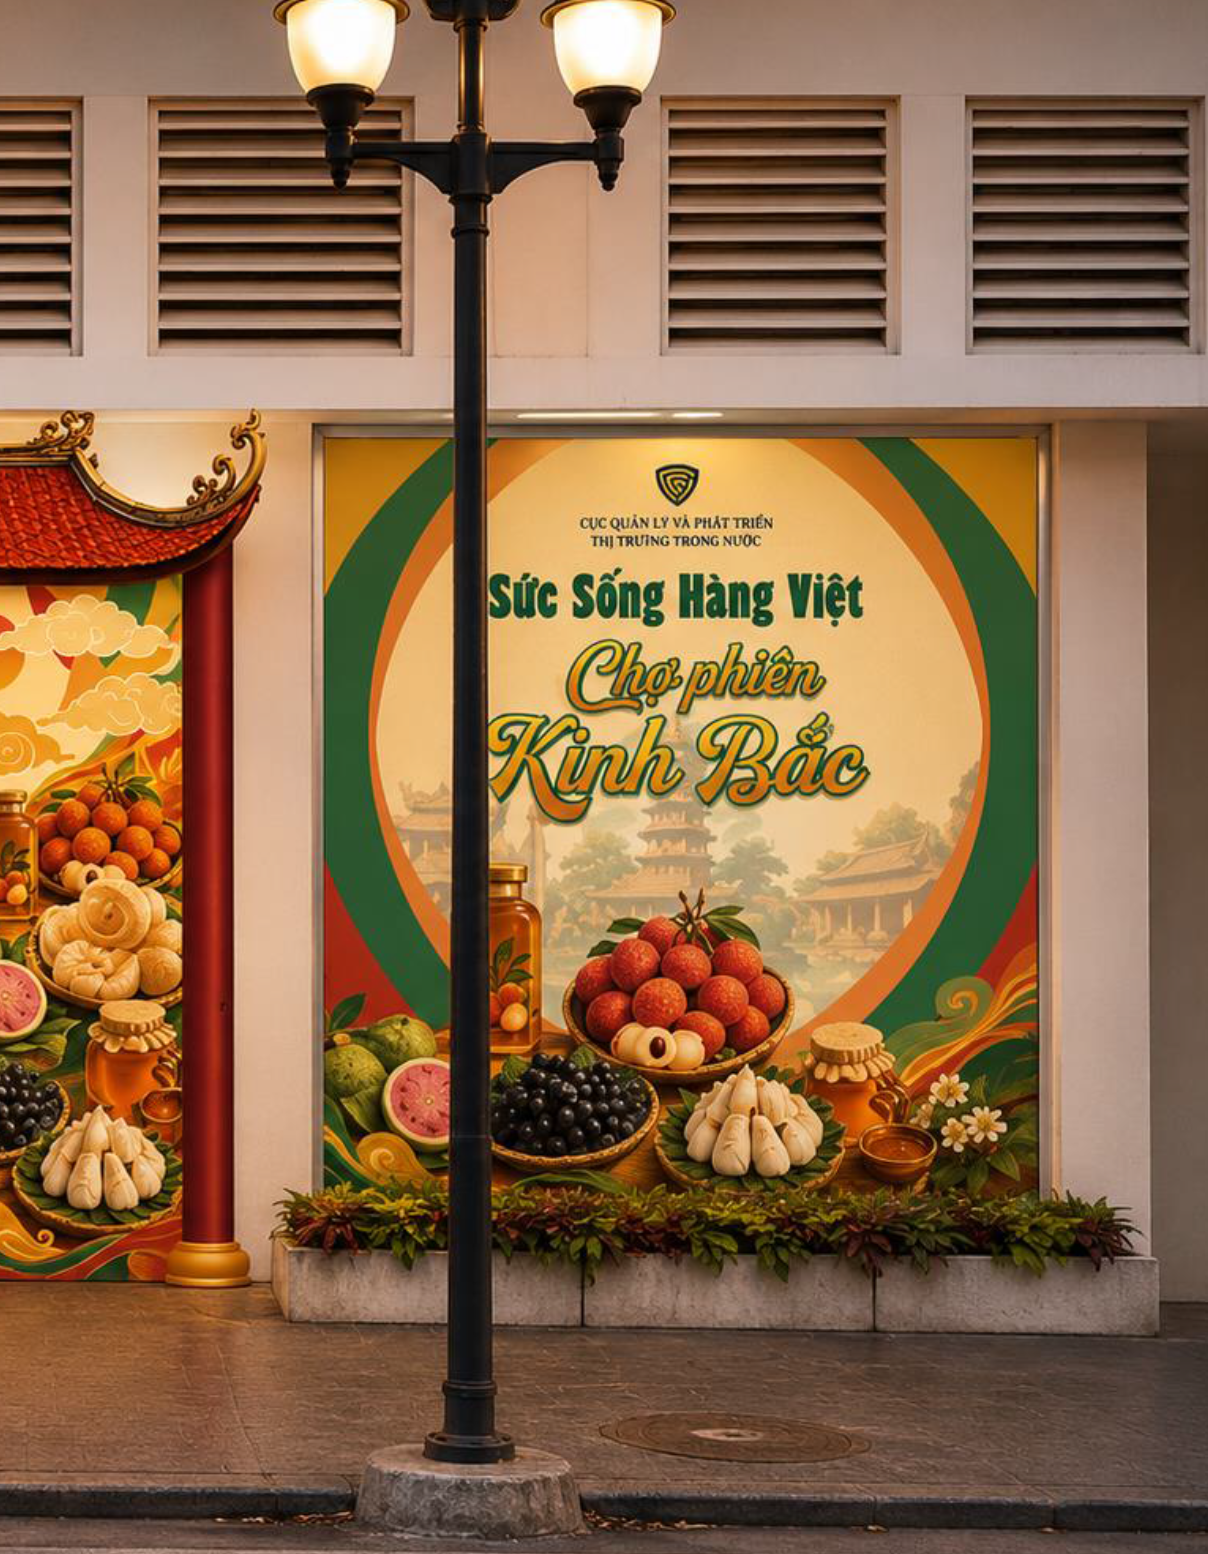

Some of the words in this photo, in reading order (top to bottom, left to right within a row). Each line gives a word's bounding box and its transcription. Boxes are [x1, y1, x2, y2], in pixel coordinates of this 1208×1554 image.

[579, 517, 607, 531] CỤC
[590, 535, 614, 549] THỊ
[673, 535, 720, 547] TRONG
[489, 572, 558, 619] Sức
[571, 567, 665, 627] Sống
[679, 573, 774, 627] Hàng
[787, 573, 864, 627] Việt
[565, 639, 683, 715] Chợ
[676, 642, 826, 715] phiên
[488, 713, 686, 824] Kinh
[695, 711, 871, 807] Bắc
